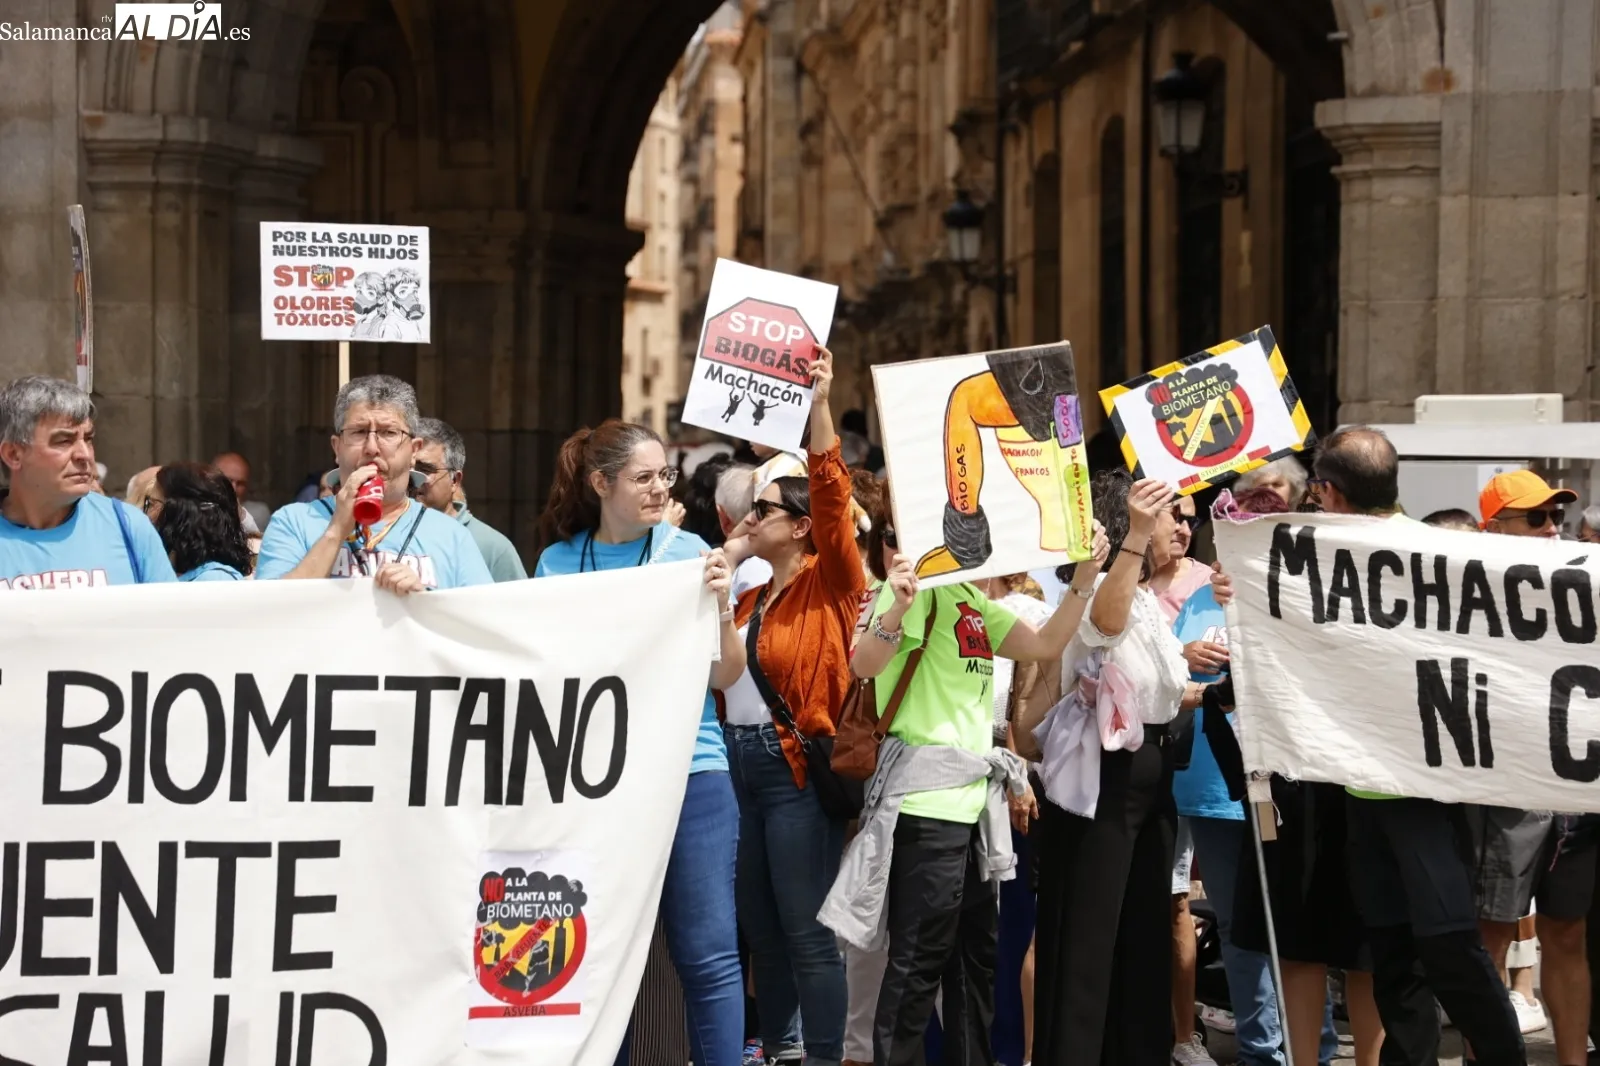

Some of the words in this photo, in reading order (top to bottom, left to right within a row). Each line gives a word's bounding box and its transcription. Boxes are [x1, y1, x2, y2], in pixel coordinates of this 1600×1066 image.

[272, 231, 307, 243] POR
[312, 231, 333, 243] LA
[337, 232, 392, 245] SALUD
[397, 234, 419, 247] DE
[272, 245, 363, 258] NUESTROS
[367, 248, 419, 260] HIJOS
[273, 295, 356, 311] OLORES
[274, 311, 357, 326] TÓXICOS
[727, 312, 805, 345] STOP
[714, 336, 810, 379] BIOGÁS
[704, 363, 803, 406] Machacón
[1171, 381, 1206, 399] PLANTA
[1206, 375, 1218, 385] DE
[1175, 377, 1187, 386] LA
[1161, 380, 1231, 416] BIOMETANO
[1015, 466, 1050, 478] FRANCOS
[42, 669, 628, 807] BIOMETANO
[506, 878, 513, 887] A
[515, 877, 528, 887] LA
[483, 877, 505, 904] NO
[504, 892, 546, 902] PLANTA
[549, 891, 562, 901] DE
[486, 903, 574, 920] BIOMETANO
[502, 1005, 547, 1017] ASVEBA
